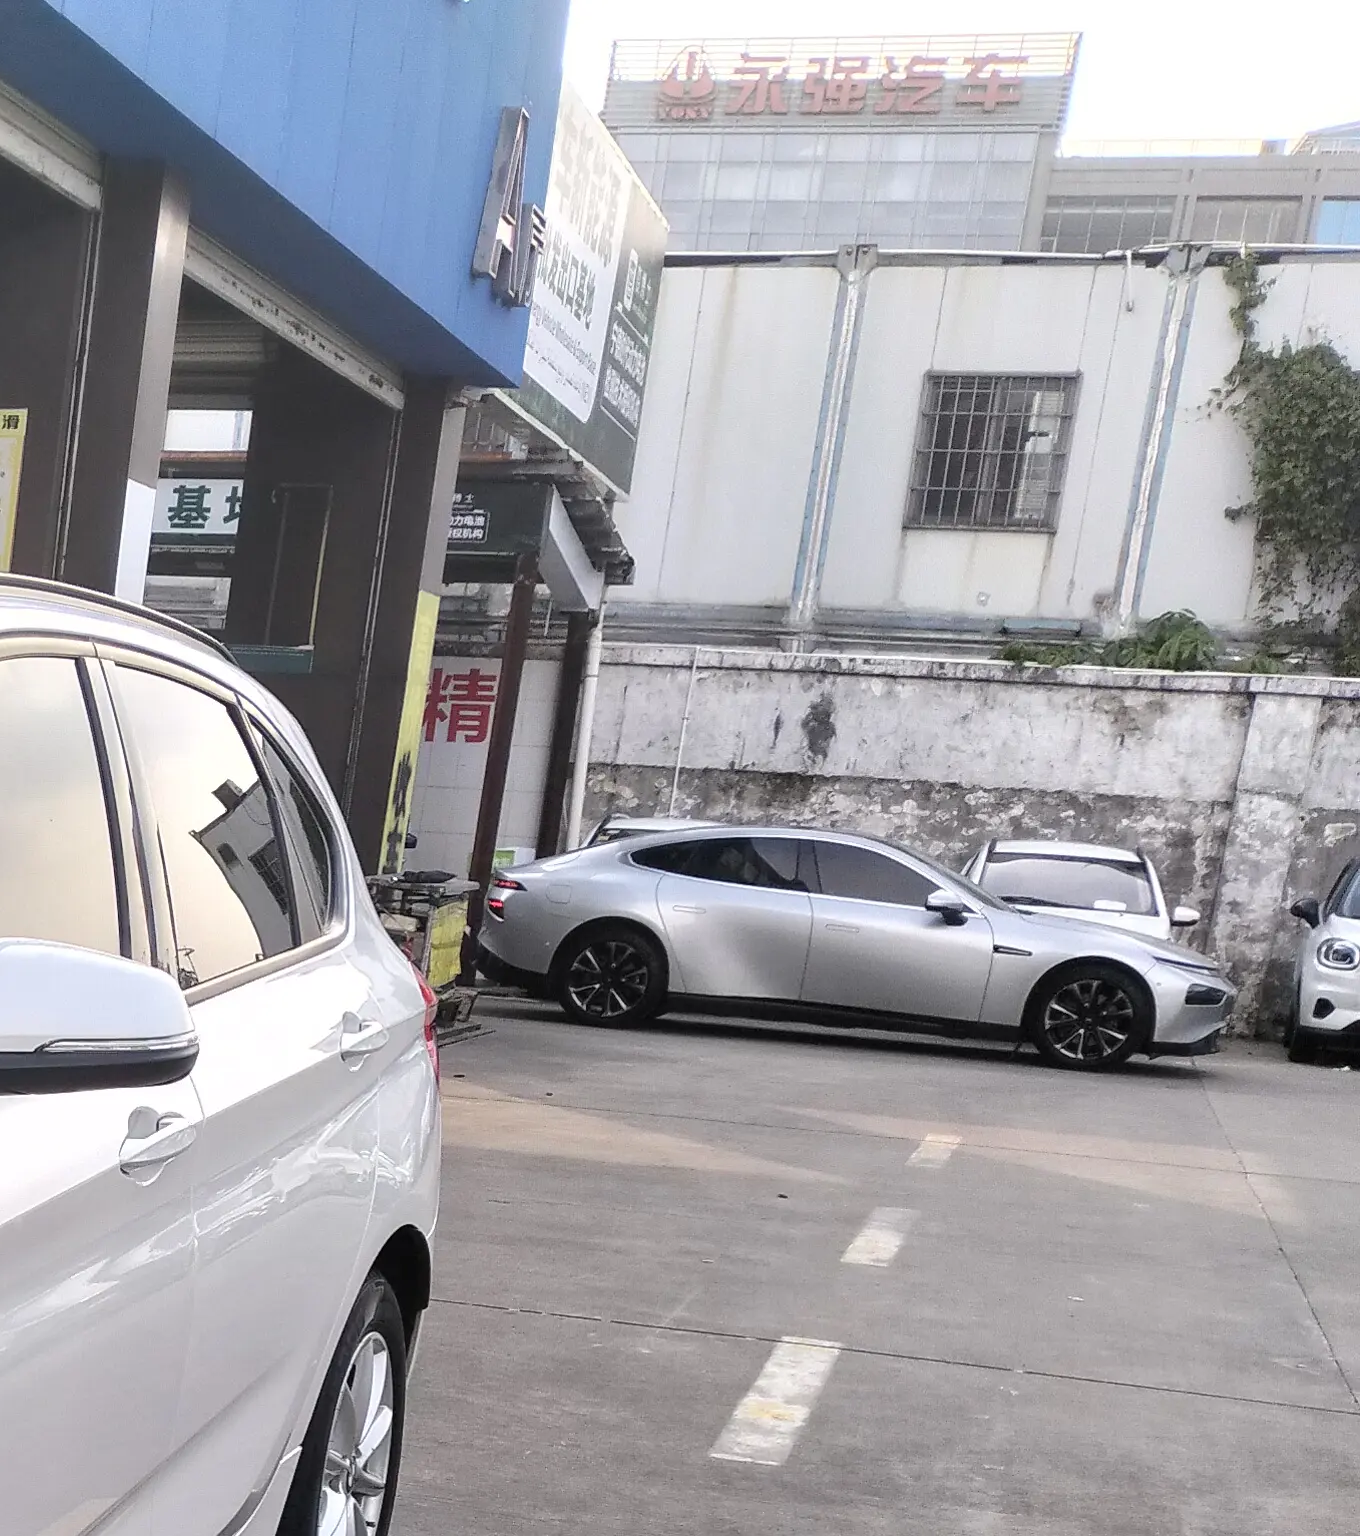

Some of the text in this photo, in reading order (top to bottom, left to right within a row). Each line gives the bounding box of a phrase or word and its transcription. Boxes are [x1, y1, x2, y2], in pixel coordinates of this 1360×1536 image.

[724, 52, 1030, 115] 永强汽车
[423, 668, 498, 743] 精
